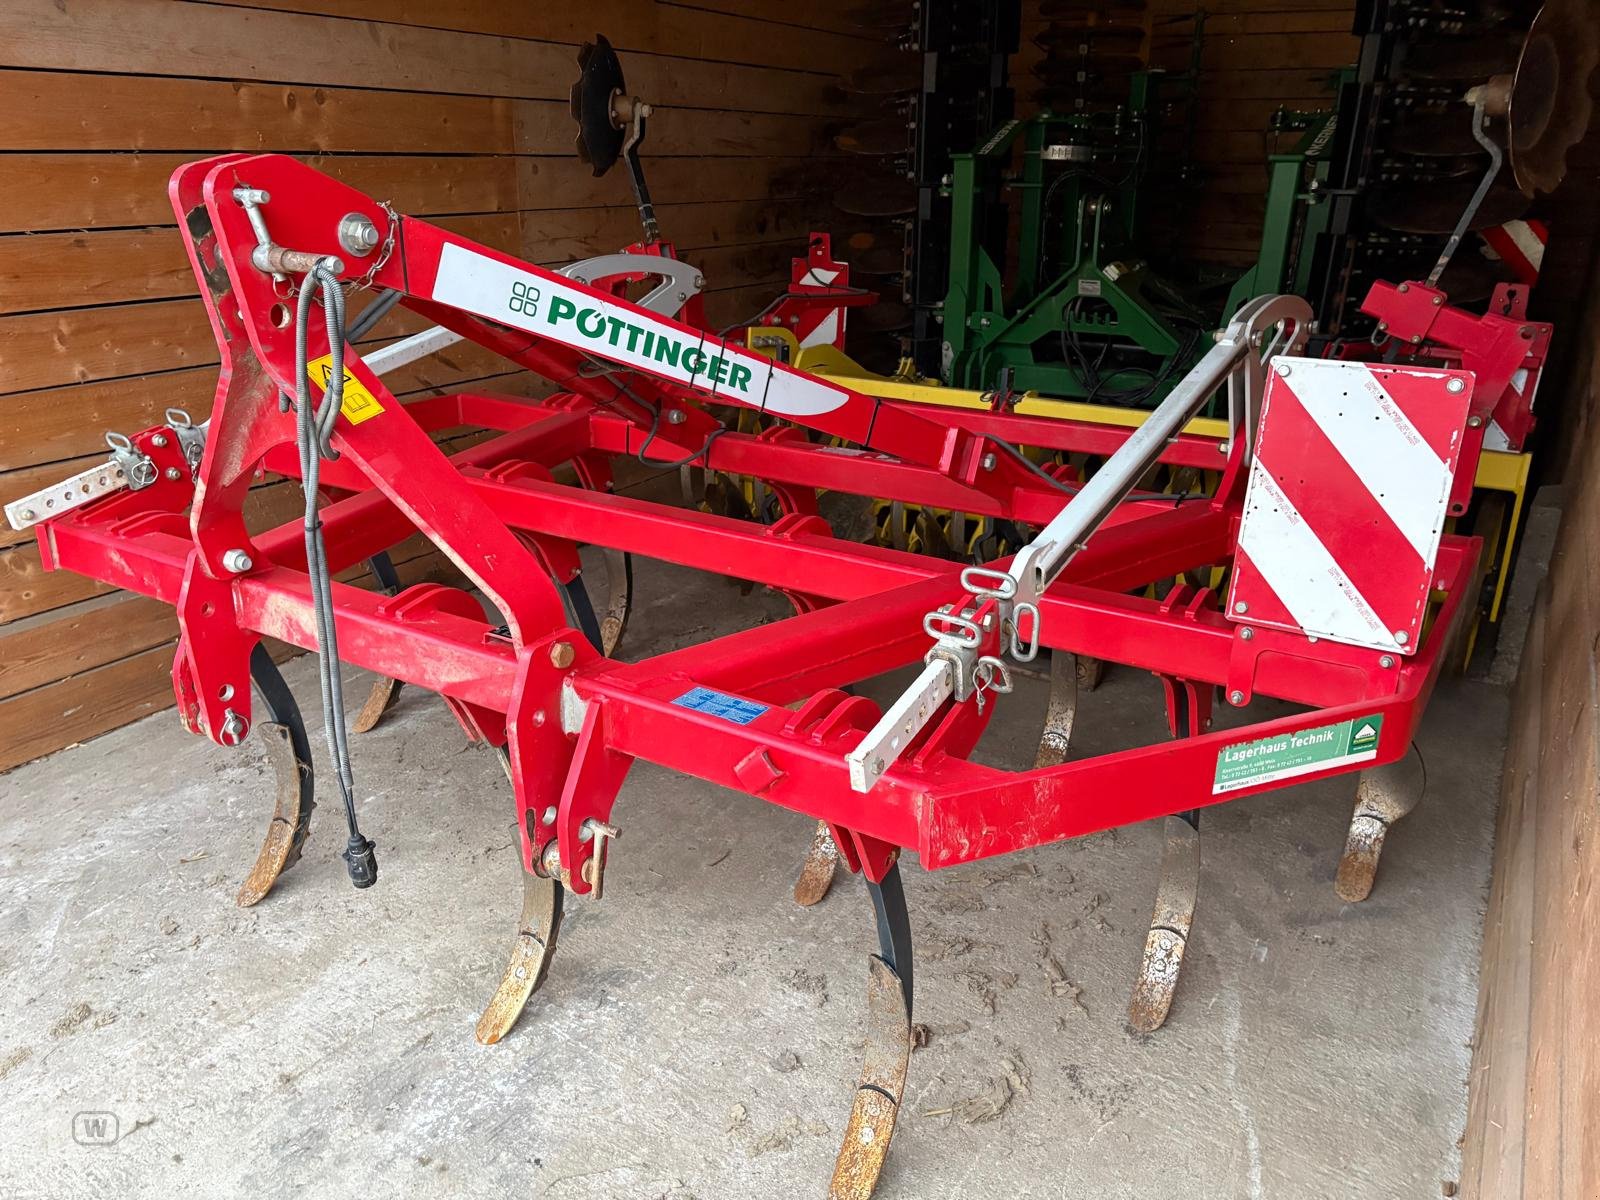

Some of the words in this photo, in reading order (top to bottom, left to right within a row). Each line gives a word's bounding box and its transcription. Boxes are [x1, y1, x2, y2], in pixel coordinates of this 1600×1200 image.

[547, 295, 752, 393] PÖTTINGER
[1225, 741, 1287, 763] Lagerhaus
[1290, 730, 1334, 749] Technik
